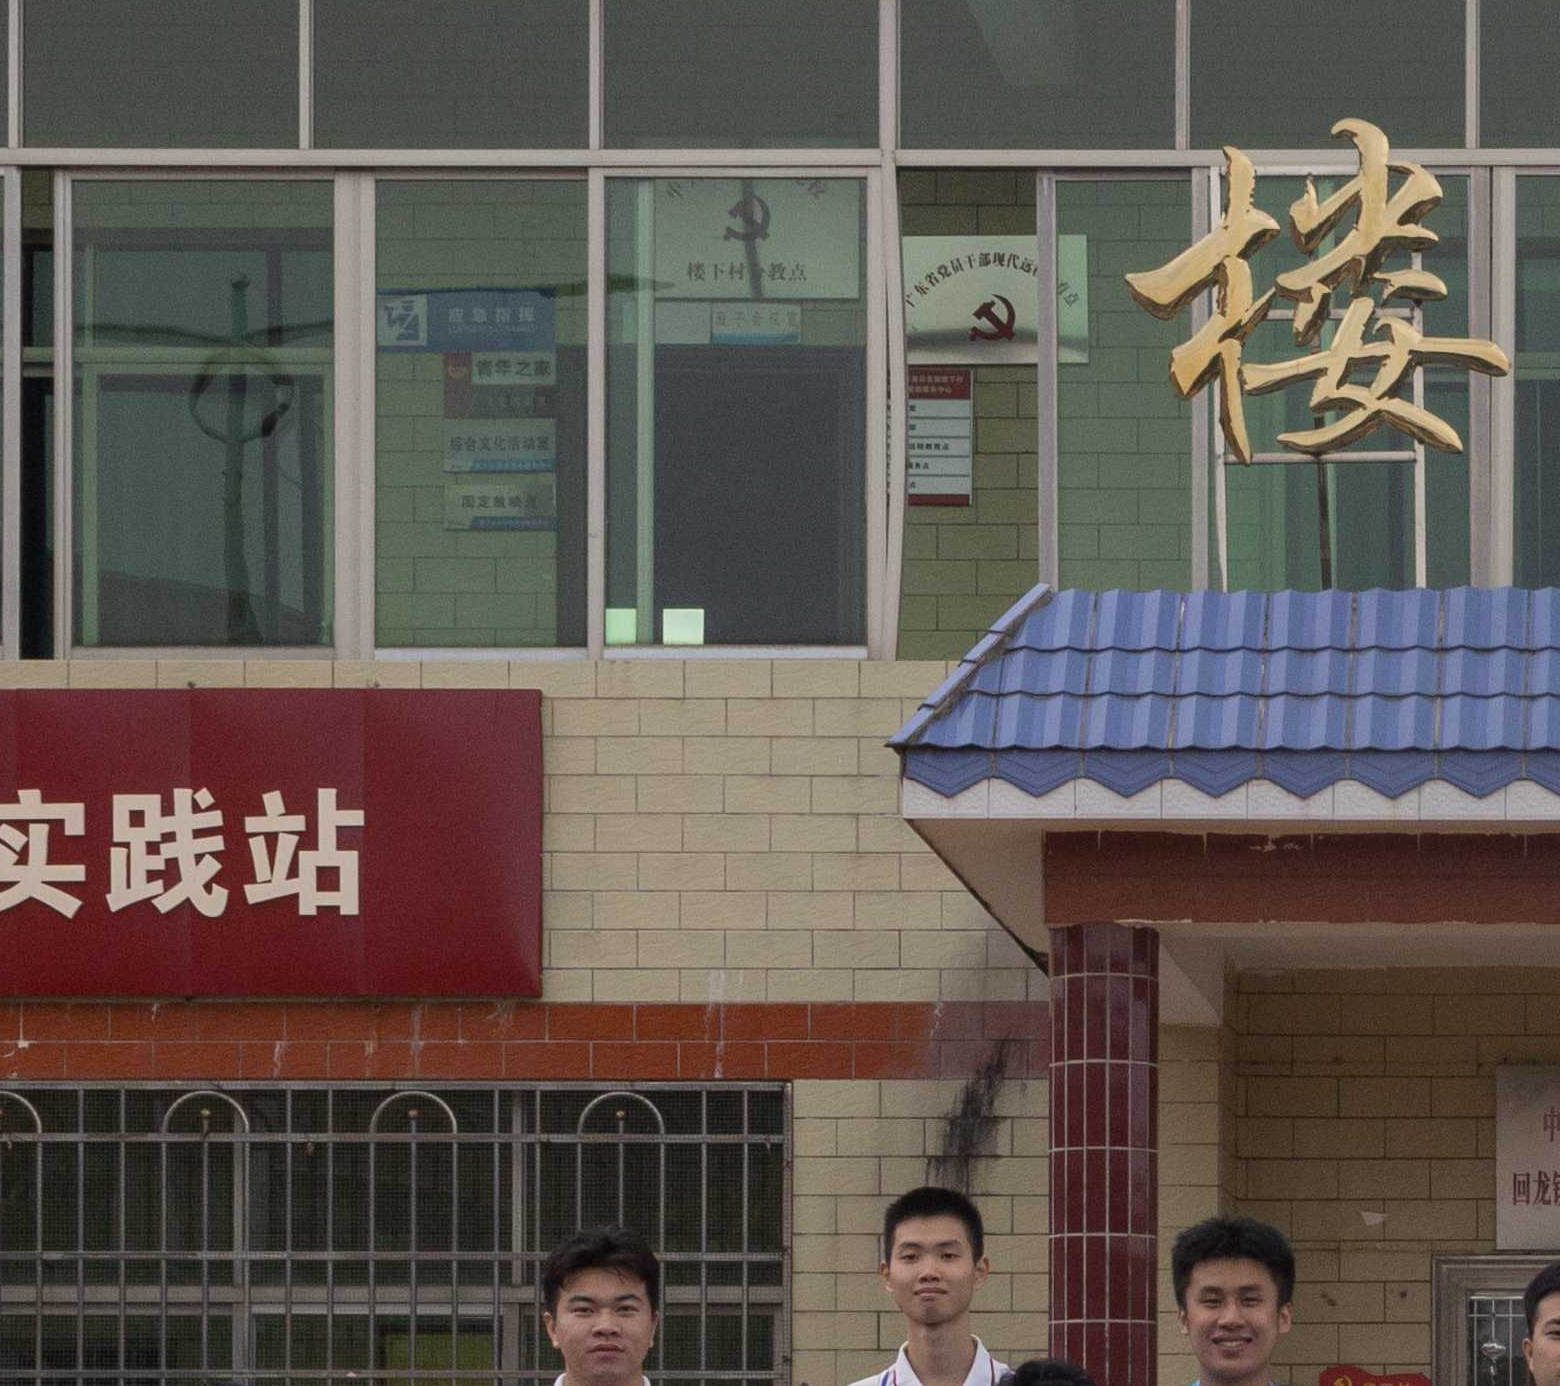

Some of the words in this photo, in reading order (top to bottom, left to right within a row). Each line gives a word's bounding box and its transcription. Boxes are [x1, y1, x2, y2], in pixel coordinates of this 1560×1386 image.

[687, 262, 808, 282] 楼下村教点
